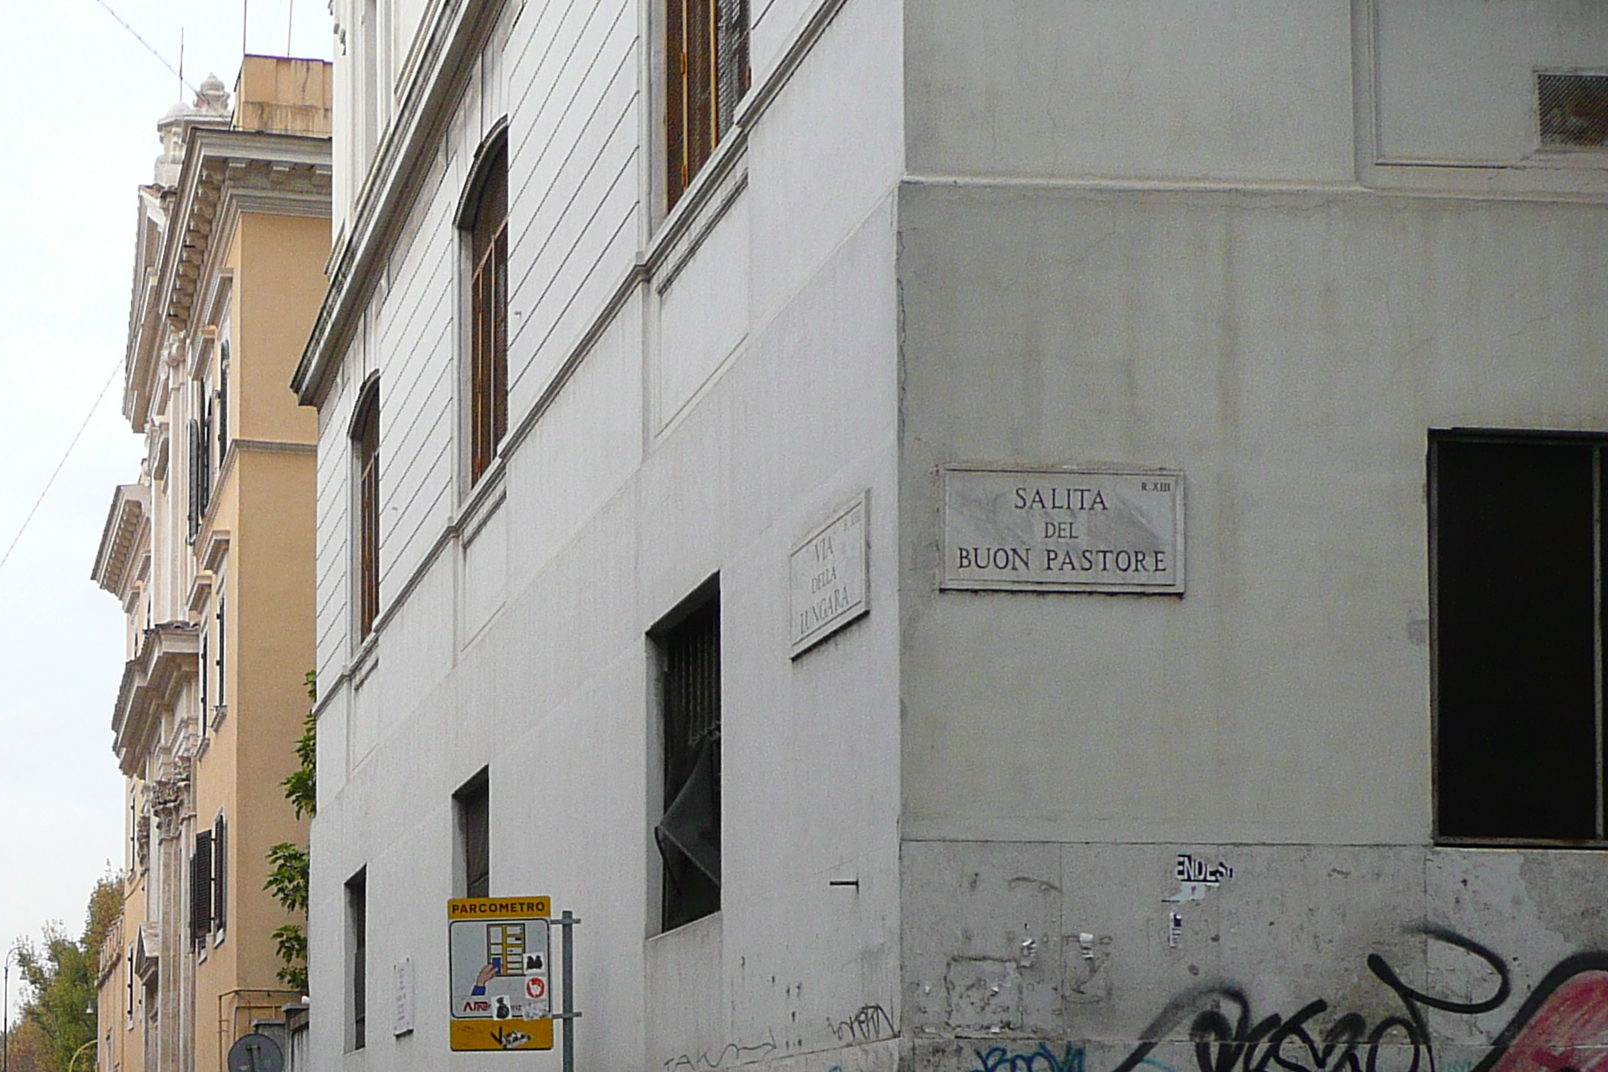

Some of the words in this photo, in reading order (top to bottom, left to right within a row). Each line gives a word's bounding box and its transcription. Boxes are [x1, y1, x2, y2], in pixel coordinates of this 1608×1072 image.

[1014, 486, 1108, 511] SALITA
[1044, 521, 1079, 539] DEL
[814, 536, 834, 562] VIA
[958, 547, 1031, 571] BUON
[1045, 548, 1167, 572] PASTORE
[811, 566, 837, 594] DELLA
[800, 586, 849, 635] LUNGARA
[452, 902, 545, 915] PARCOMETRO
